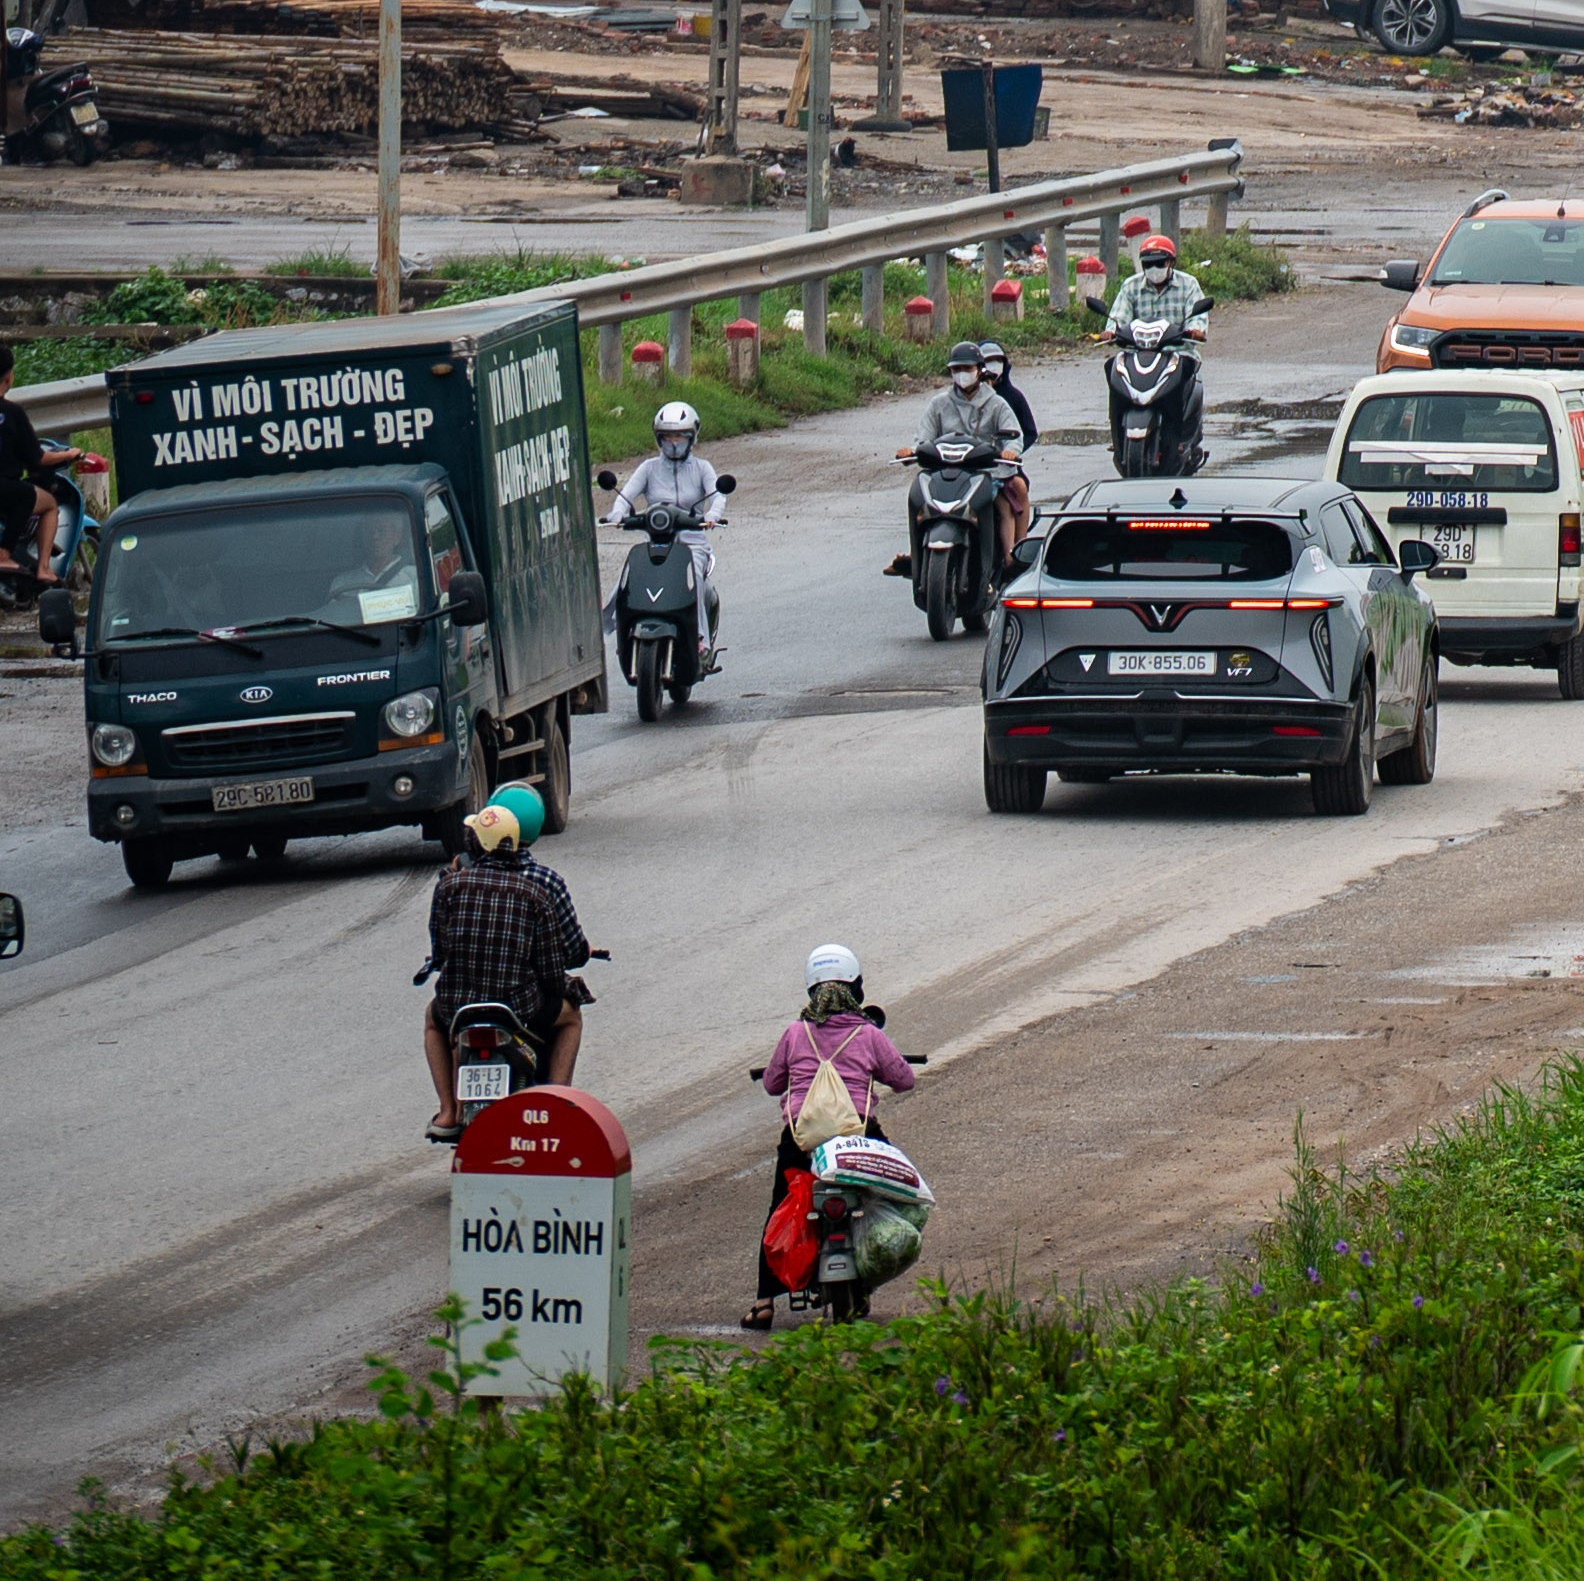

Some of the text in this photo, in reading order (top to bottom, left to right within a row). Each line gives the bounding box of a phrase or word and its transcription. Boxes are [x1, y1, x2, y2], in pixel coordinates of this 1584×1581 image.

[172, 366, 406, 422] VÌ MÔI TRƯỜNG
[152, 425, 238, 467] XANH
[260, 415, 345, 460] SẠCH
[374, 407, 435, 449] ĐẸP
[1407, 491, 1489, 508] 29D-058.18
[1433, 524, 1462, 542] 29D
[317, 670, 391, 686] FRONTIER
[127, 691, 178, 704] THACO
[466, 1083, 502, 1098] 1064
[522, 1109, 549, 1125] QL6
[510, 1136, 560, 1152] Km 17
[462, 1206, 604, 1256] HÒA BÌNH
[481, 1287, 582, 1324] 56 km
